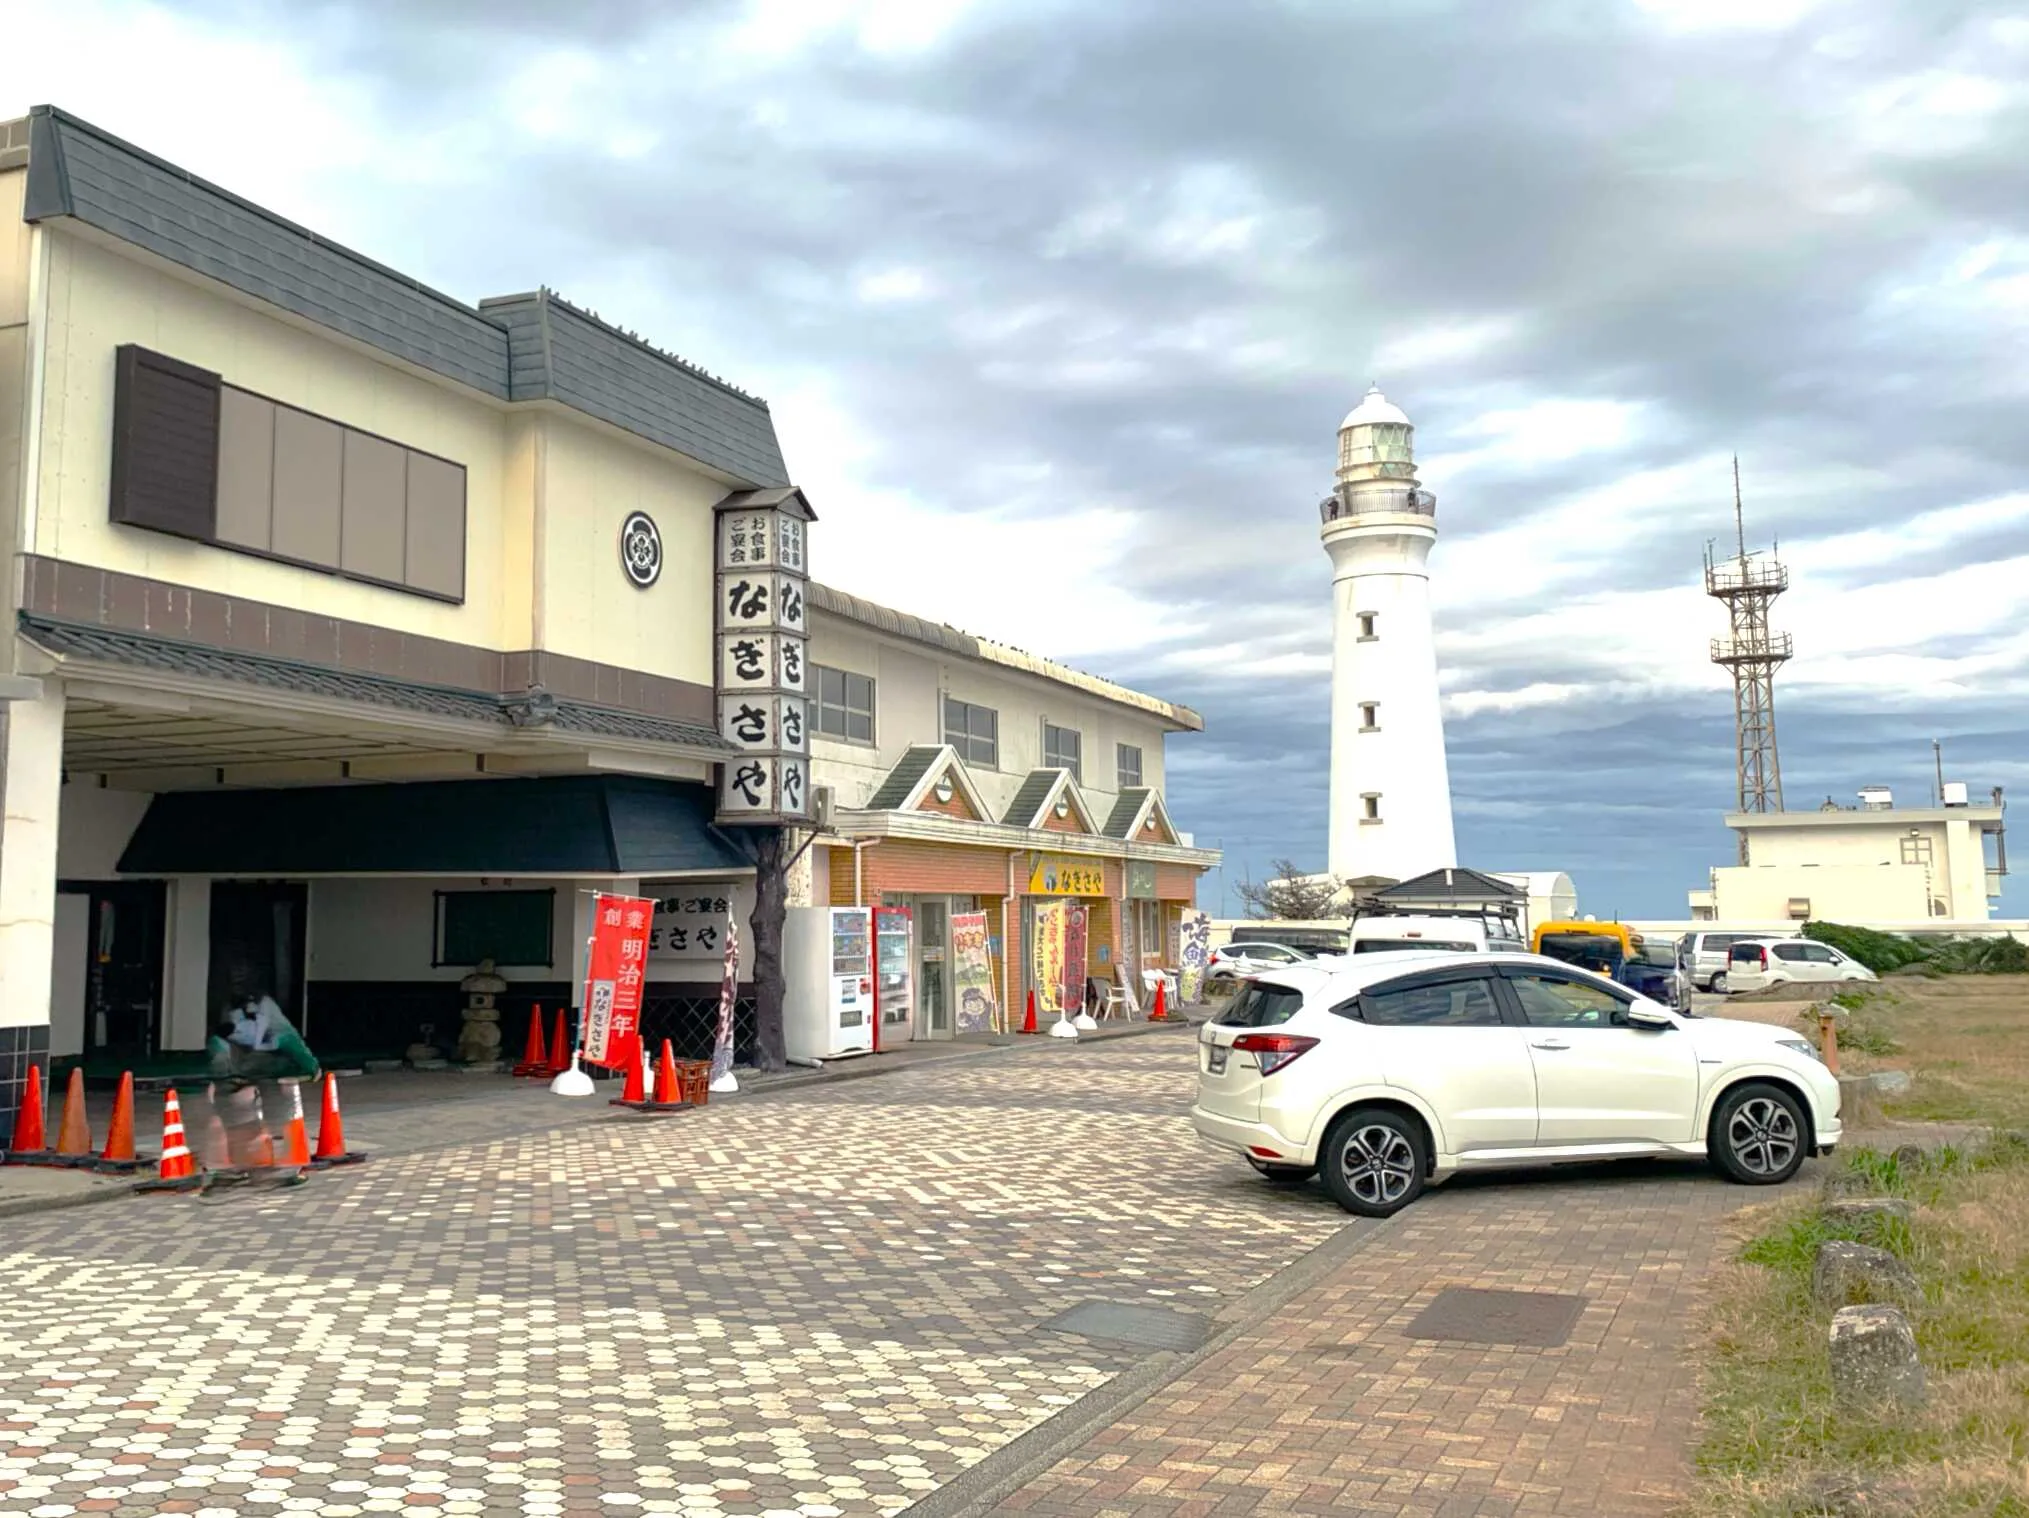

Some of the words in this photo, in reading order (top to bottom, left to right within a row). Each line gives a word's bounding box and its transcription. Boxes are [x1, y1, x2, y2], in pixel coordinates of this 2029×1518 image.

[730, 516, 747, 563] ご宴会
[750, 516, 766, 562] お食事
[729, 579, 768, 807] なぎさや
[781, 582, 801, 808] なぎさや
[603, 908, 645, 930] 創業
[610, 938, 644, 1038] 明治三年
